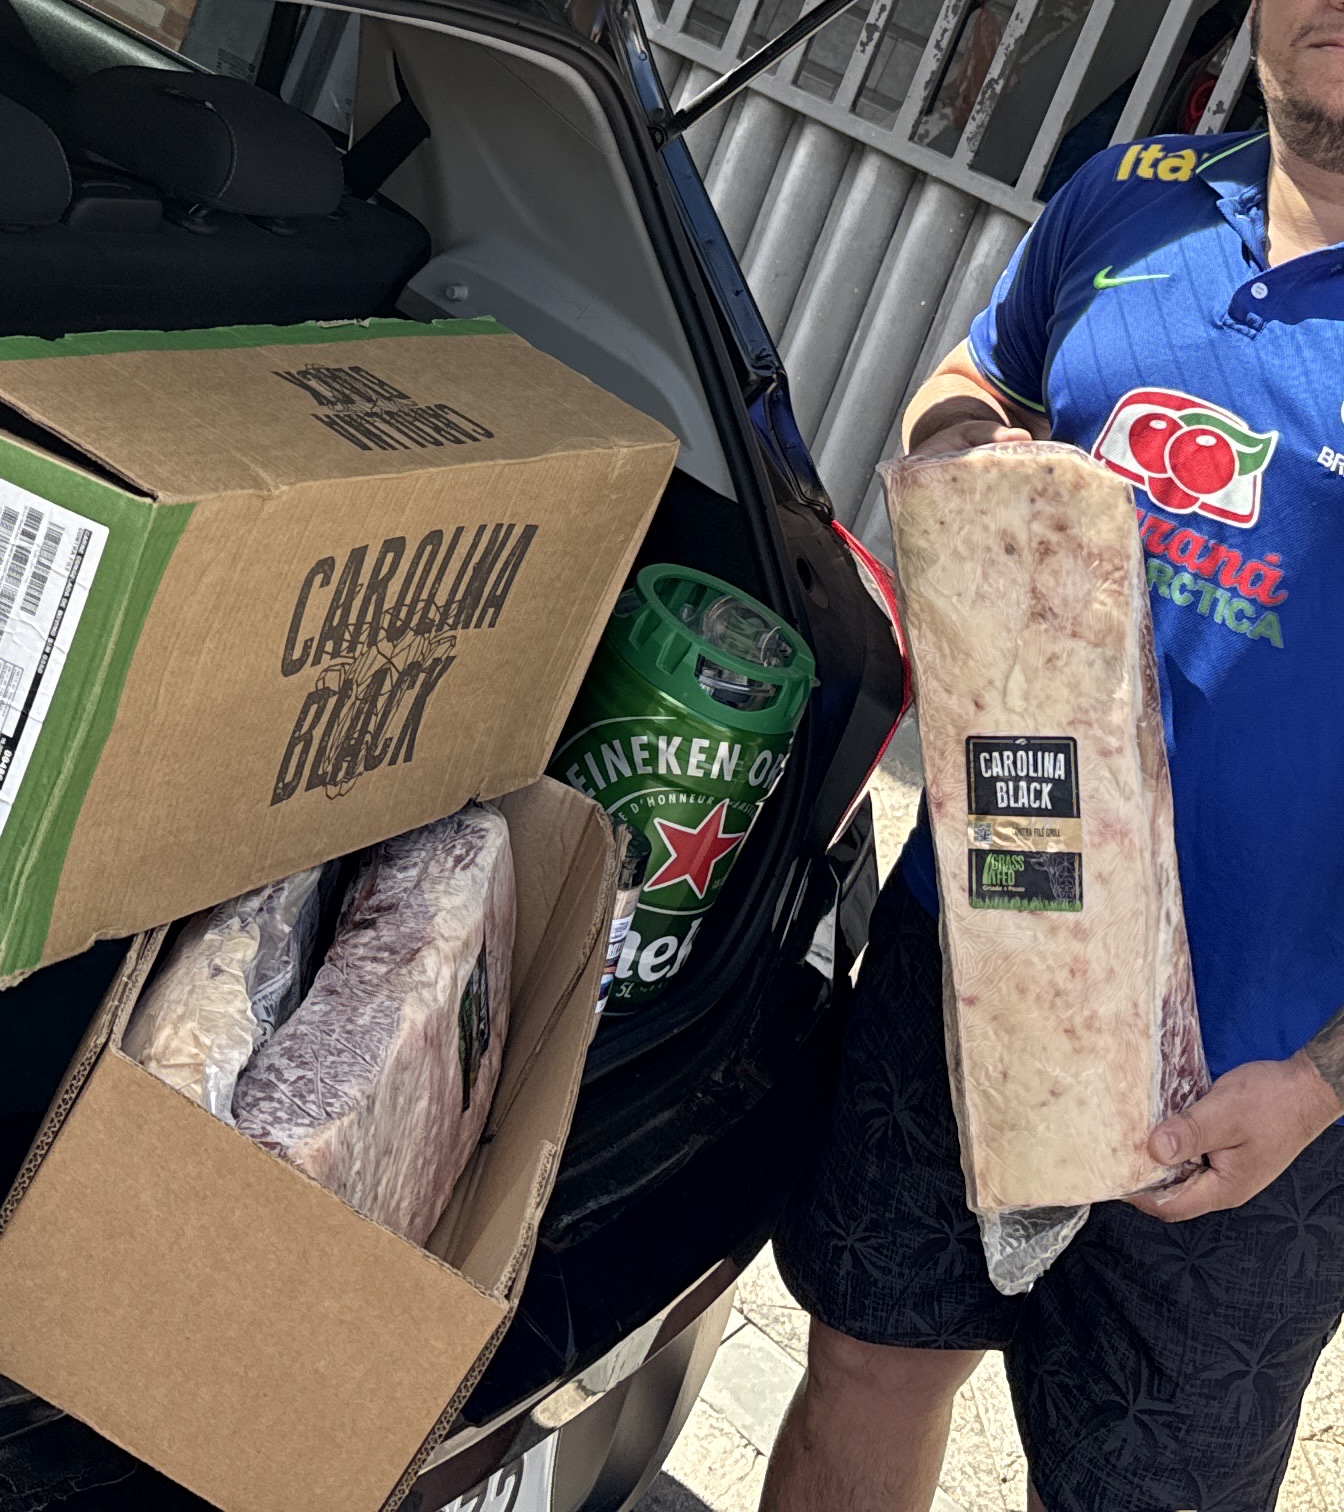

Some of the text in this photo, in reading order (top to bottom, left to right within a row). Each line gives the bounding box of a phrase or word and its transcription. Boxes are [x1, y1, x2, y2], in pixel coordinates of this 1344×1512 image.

[1116, 144, 1204, 182] Ita
[271, 366, 412, 407] BLACK
[310, 403, 495, 451] CAROLINA
[1136, 508, 1289, 606] raná
[280, 522, 540, 678] CAROLINA
[1146, 557, 1284, 649] RCTICA
[269, 655, 455, 806] BLACK
[565, 735, 742, 798] EINEKEN
[979, 750, 1066, 781] CAROLINA
[995, 781, 1053, 810] BLACK
[991, 854, 1025, 872] GRASS
